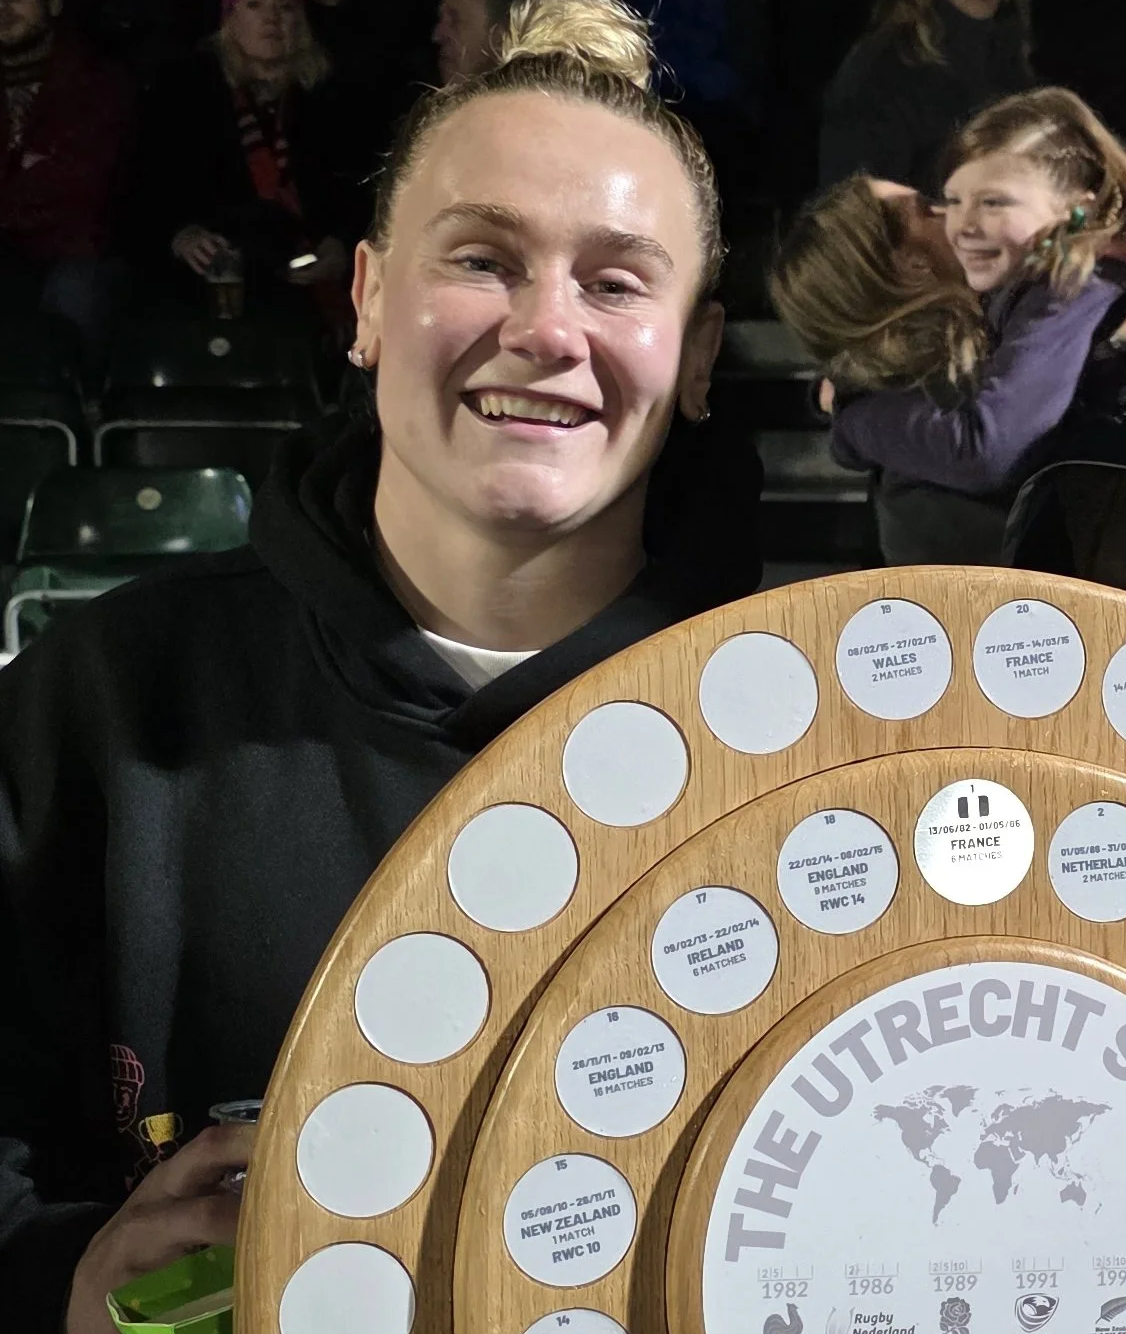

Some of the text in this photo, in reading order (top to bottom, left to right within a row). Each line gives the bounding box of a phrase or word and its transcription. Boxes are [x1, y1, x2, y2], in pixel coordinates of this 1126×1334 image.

[1016, 604, 1029, 613] 20
[872, 653, 916, 669] WALES
[1006, 652, 1053, 667] FRANCE
[1019, 667, 1049, 678] MATCH
[971, 785, 974, 793] 1
[1098, 808, 1104, 817] 2
[951, 836, 1000, 850] FRANCE
[808, 863, 868, 883] ENGLAND
[1083, 875, 1088, 883] 2
[696, 893, 706, 904] 17
[820, 893, 865, 911] RWC 14
[687, 939, 744, 965] IRELAND
[588, 1061, 654, 1085] ENGLAND
[725, 1110, 822, 1262] THE
[790, 978, 1106, 1118] UTRECHT
[555, 1159, 567, 1171] 15
[521, 1204, 620, 1239] NEW ZEALAND
[552, 1241, 600, 1263] RWC 10
[762, 1281, 808, 1299] 1982
[848, 1278, 894, 1296] 1986
[933, 1274, 977, 1292] 1989
[1016, 1272, 1059, 1289] 1991
[556, 1315, 570, 1327] 14
[854, 1313, 893, 1326] Rugby
